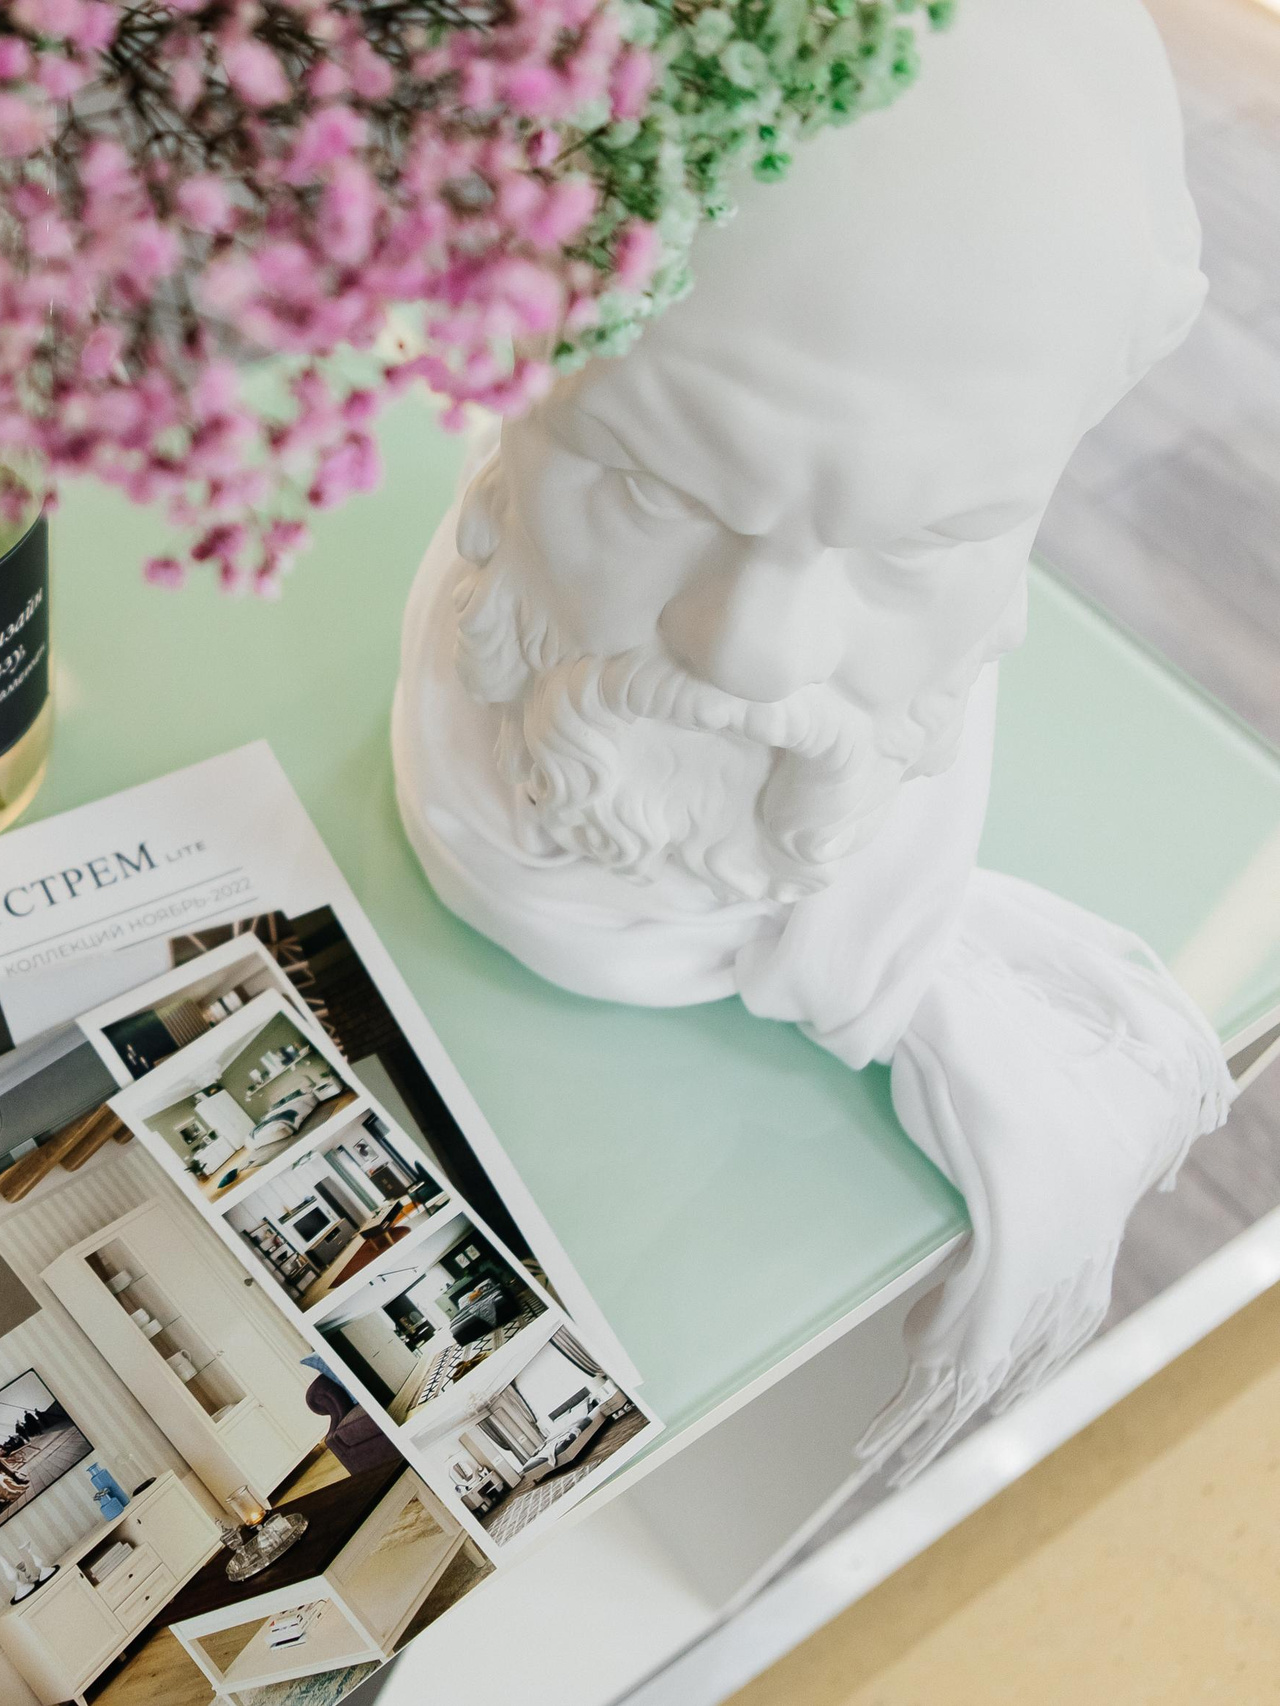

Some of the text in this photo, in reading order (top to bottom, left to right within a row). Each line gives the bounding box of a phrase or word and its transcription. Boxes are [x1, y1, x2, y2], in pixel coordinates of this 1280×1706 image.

[165, 840, 207, 866] LITE
[128, 897, 207, 932] НОЯБРЬ
[210, 876, 252, 902] 2022
